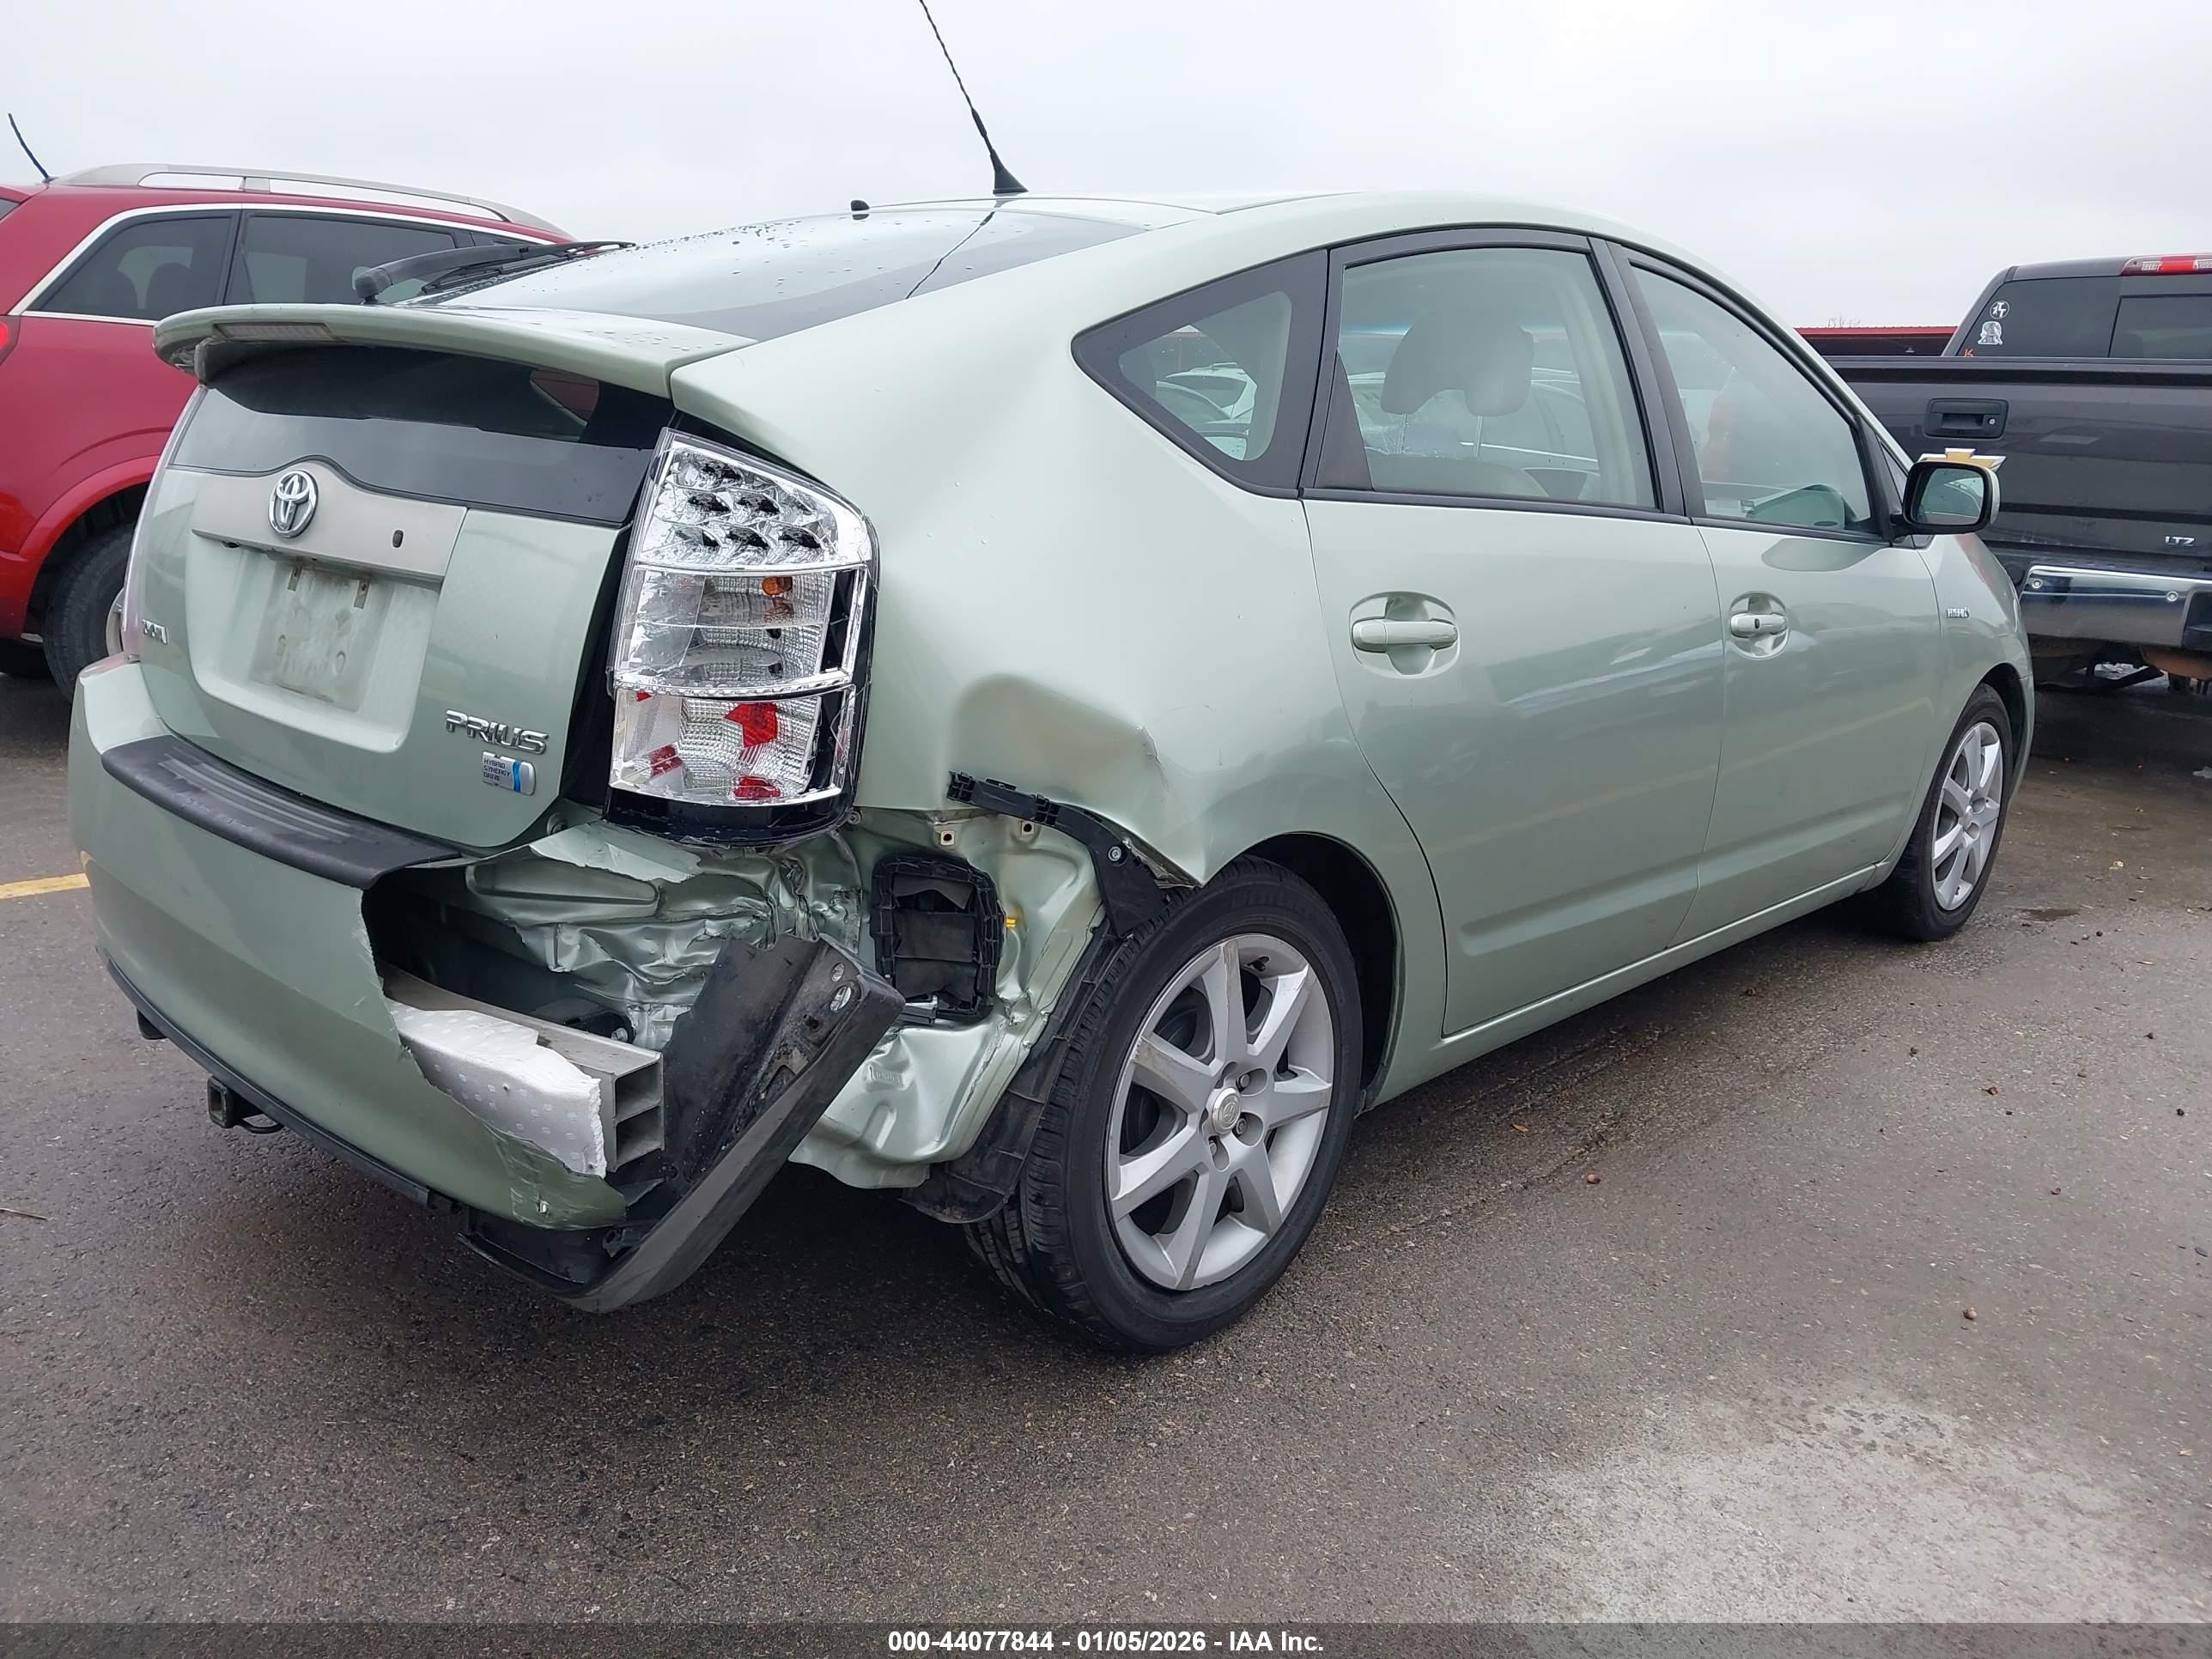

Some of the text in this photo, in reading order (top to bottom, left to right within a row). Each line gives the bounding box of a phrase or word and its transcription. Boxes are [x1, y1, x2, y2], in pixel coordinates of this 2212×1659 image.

[2165, 536, 2195, 547] LTZ
[446, 709, 549, 755] PRIUS
[483, 757, 506, 769] HYBRID
[483, 765, 511, 777] SYNERGY
[483, 772, 501, 781] DRIVE
